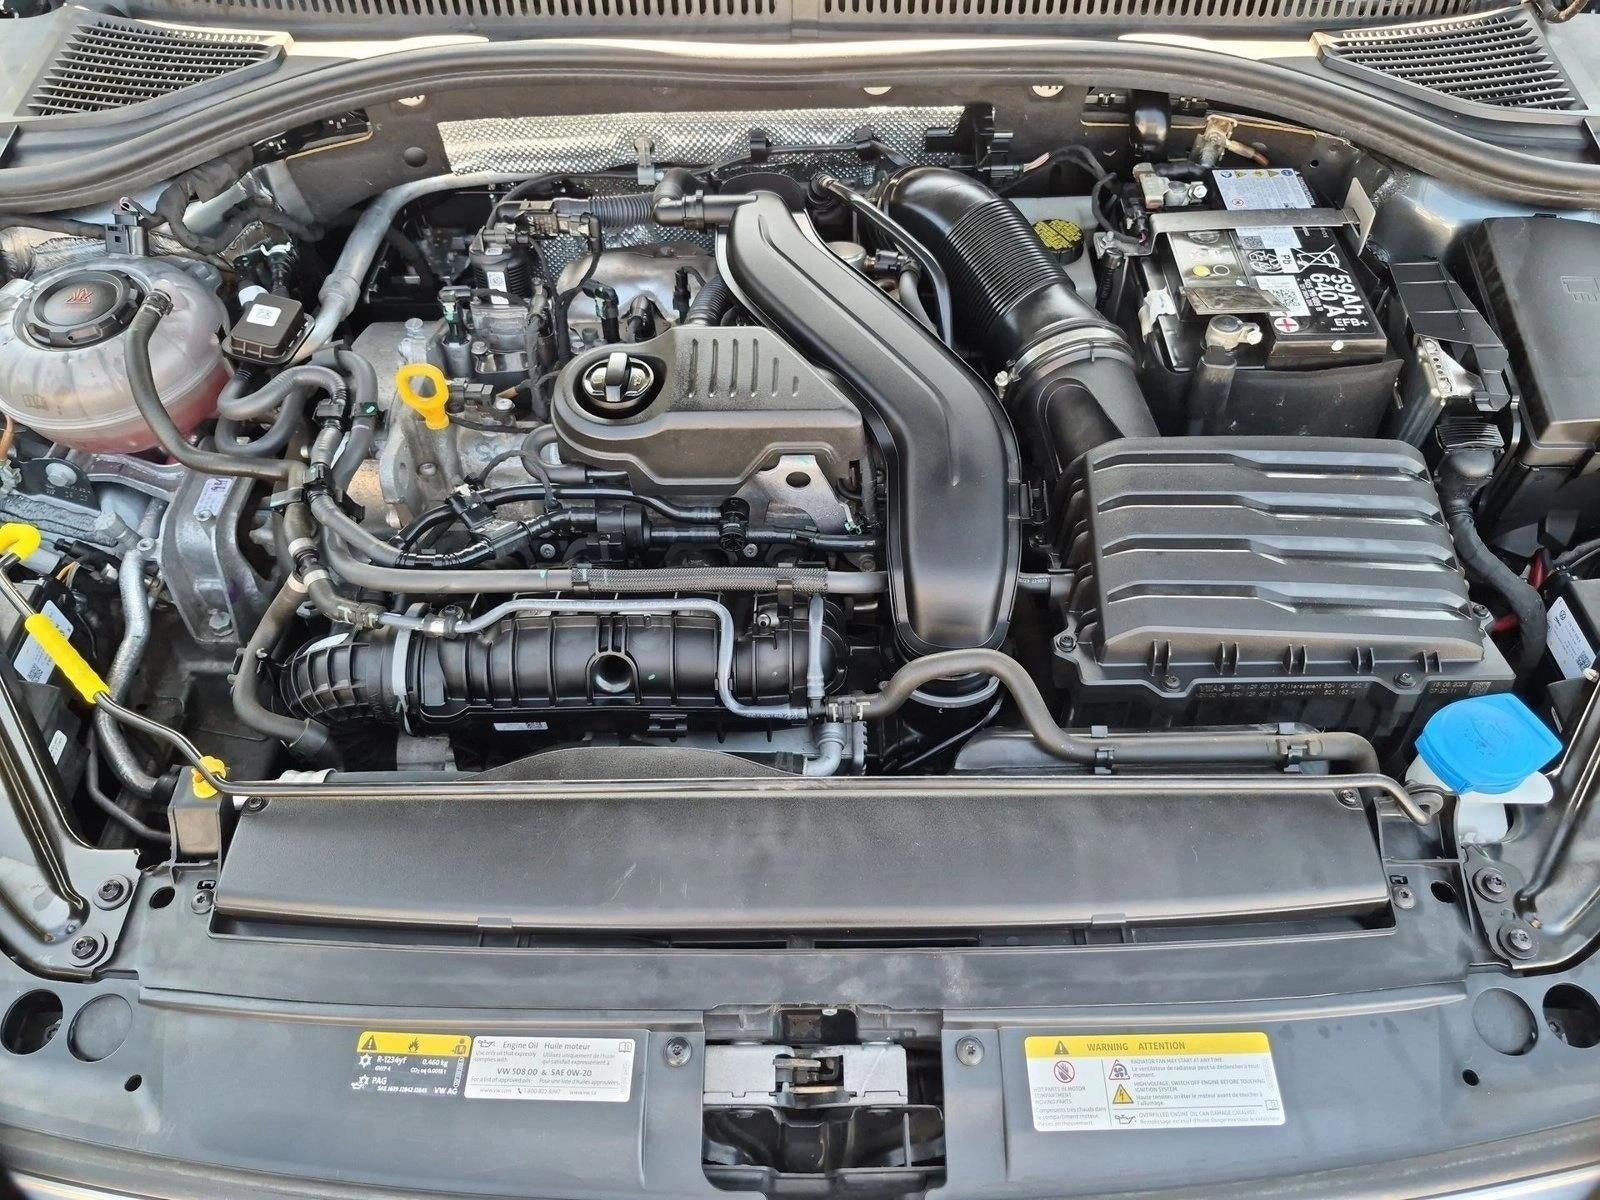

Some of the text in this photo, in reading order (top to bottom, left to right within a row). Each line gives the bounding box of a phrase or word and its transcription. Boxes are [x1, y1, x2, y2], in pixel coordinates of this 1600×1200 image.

[1281, 254, 1293, 266] Pb
[1309, 272, 1339, 301] 640
[1330, 274, 1365, 315] 59Ah
[1334, 317, 1369, 327] EFB+
[502, 1041, 527, 1050] Engine
[527, 1041, 539, 1049] Oil
[544, 1042, 563, 1050] Huile
[1086, 1041, 1186, 1052] WARNING ATTENTION
[440, 1059, 448, 1068] kg
[566, 1069, 592, 1077] 0W-20
[372, 1077, 387, 1085] PAG
[446, 1087, 458, 1095] AG
